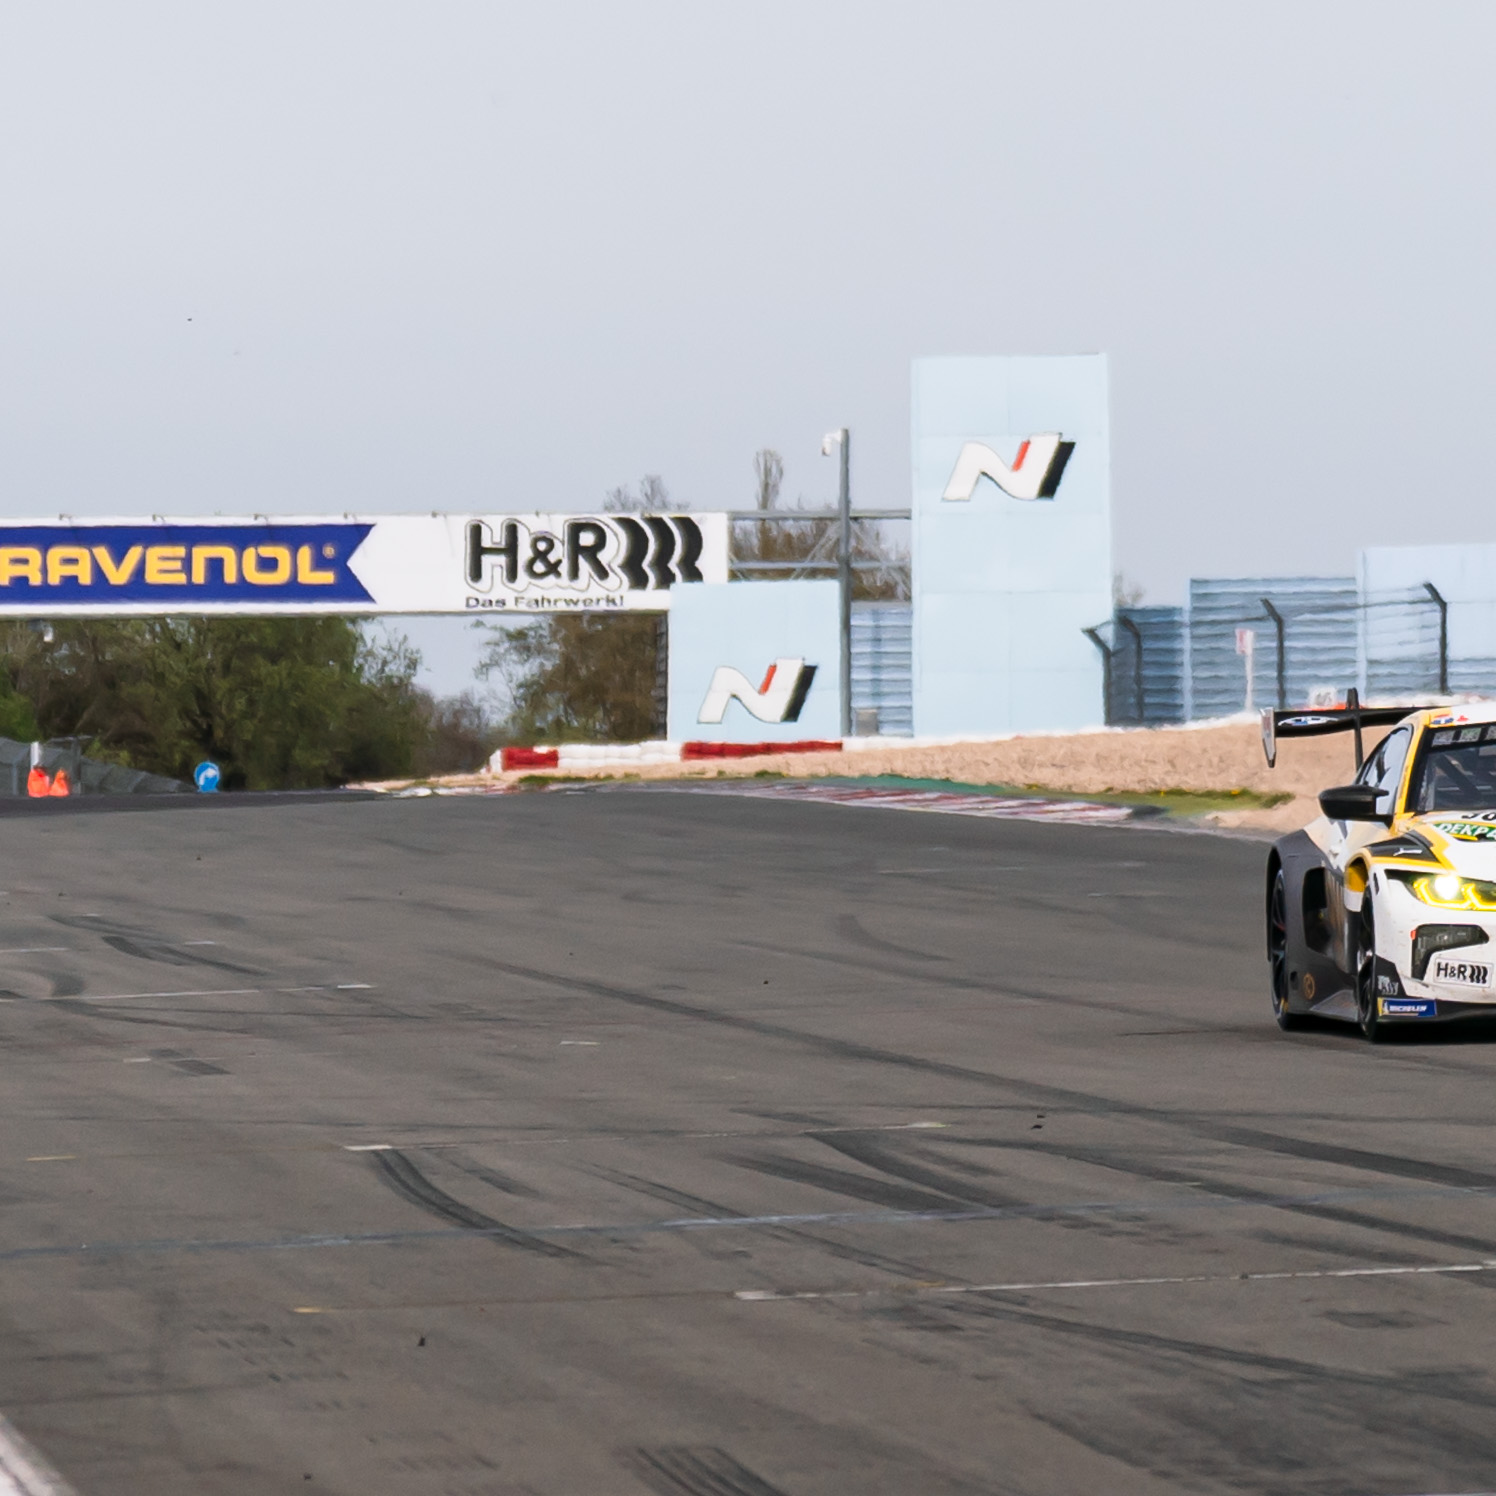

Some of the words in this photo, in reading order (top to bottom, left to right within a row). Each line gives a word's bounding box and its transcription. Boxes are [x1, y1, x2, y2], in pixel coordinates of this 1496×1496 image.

[468, 521, 610, 583] H&R
[465, 596, 507, 609] Das
[514, 595, 624, 609] Fahrwerk!
[1436, 962, 1467, 980] H&R
